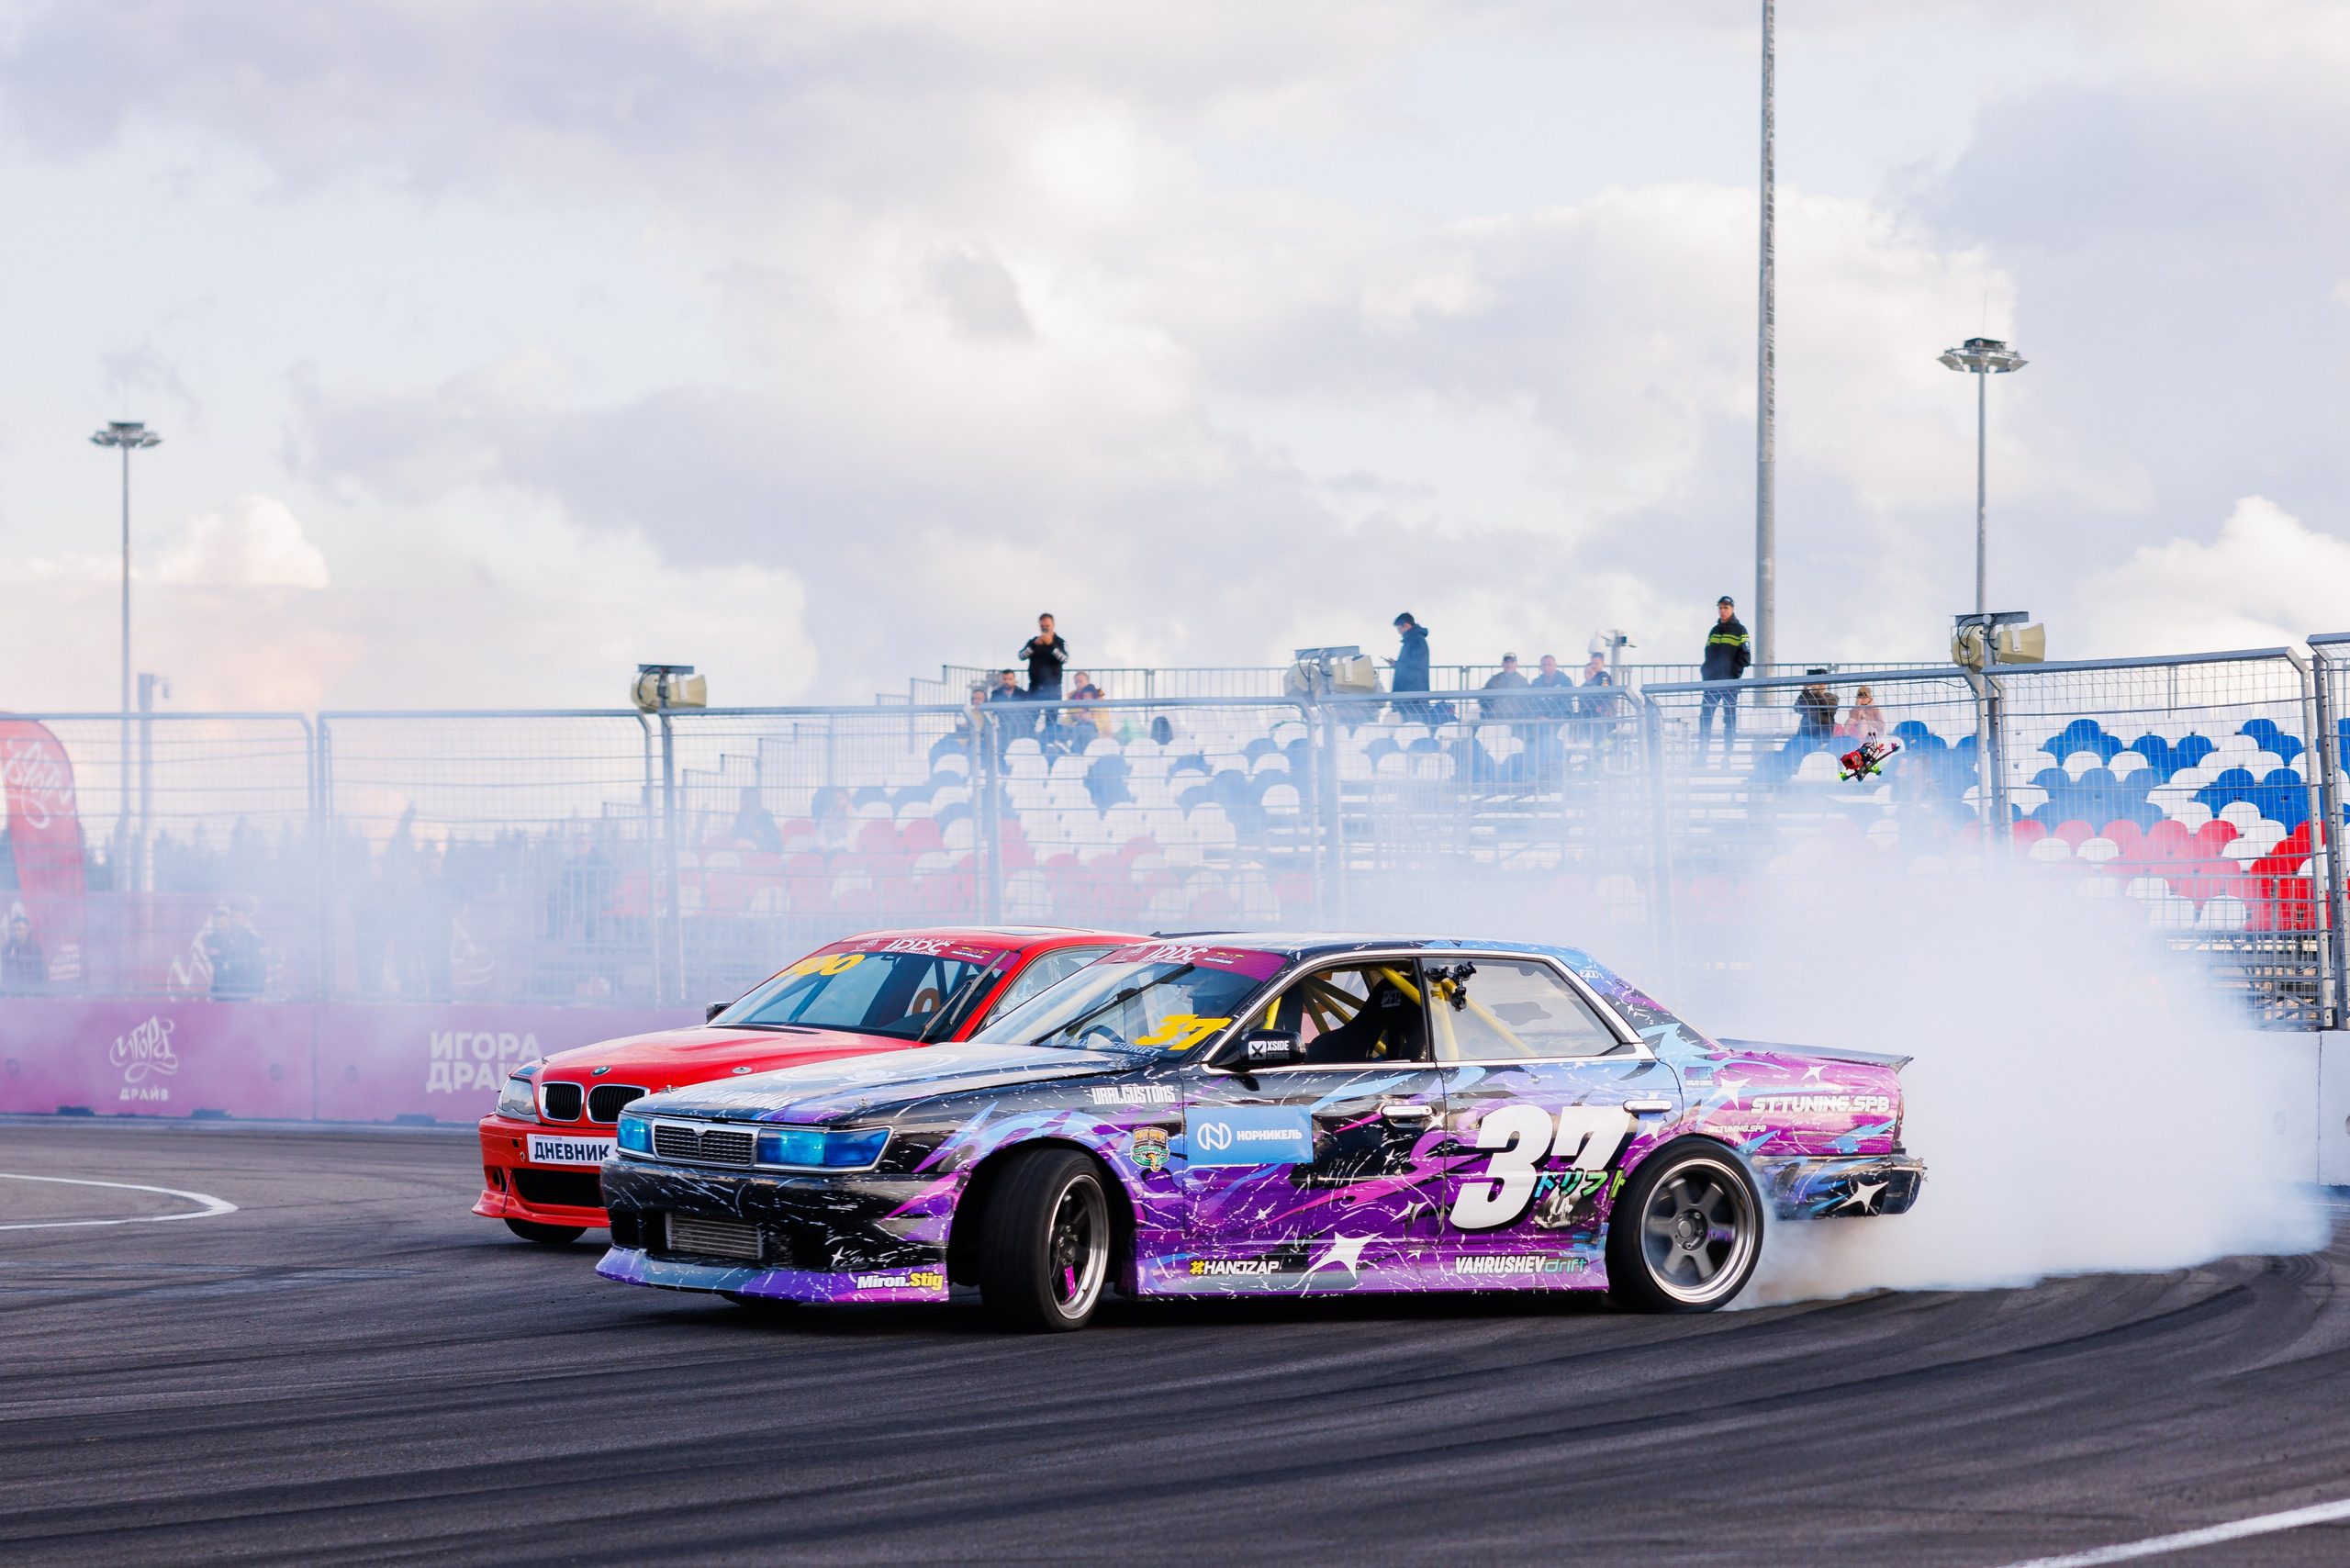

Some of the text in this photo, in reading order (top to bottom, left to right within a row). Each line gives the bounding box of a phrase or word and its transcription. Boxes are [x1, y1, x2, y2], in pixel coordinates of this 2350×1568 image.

[883, 939, 951, 953] IDDC
[1145, 946, 1209, 961] IDDC
[1133, 1014, 1233, 1050] 37
[430, 1031, 543, 1062] ИГОРА
[1267, 1040, 1290, 1051] XSIDE
[119, 1085, 169, 1101] ДРАЙВ
[1750, 1095, 1891, 1114] STTUNING.SPB
[1237, 1129, 1303, 1141] НОРНИКЕЛЬ
[534, 1141, 610, 1161] ДНЕВНИК
[1449, 1104, 1632, 1229] 37
[1534, 1170, 1626, 1198] ドリフト
